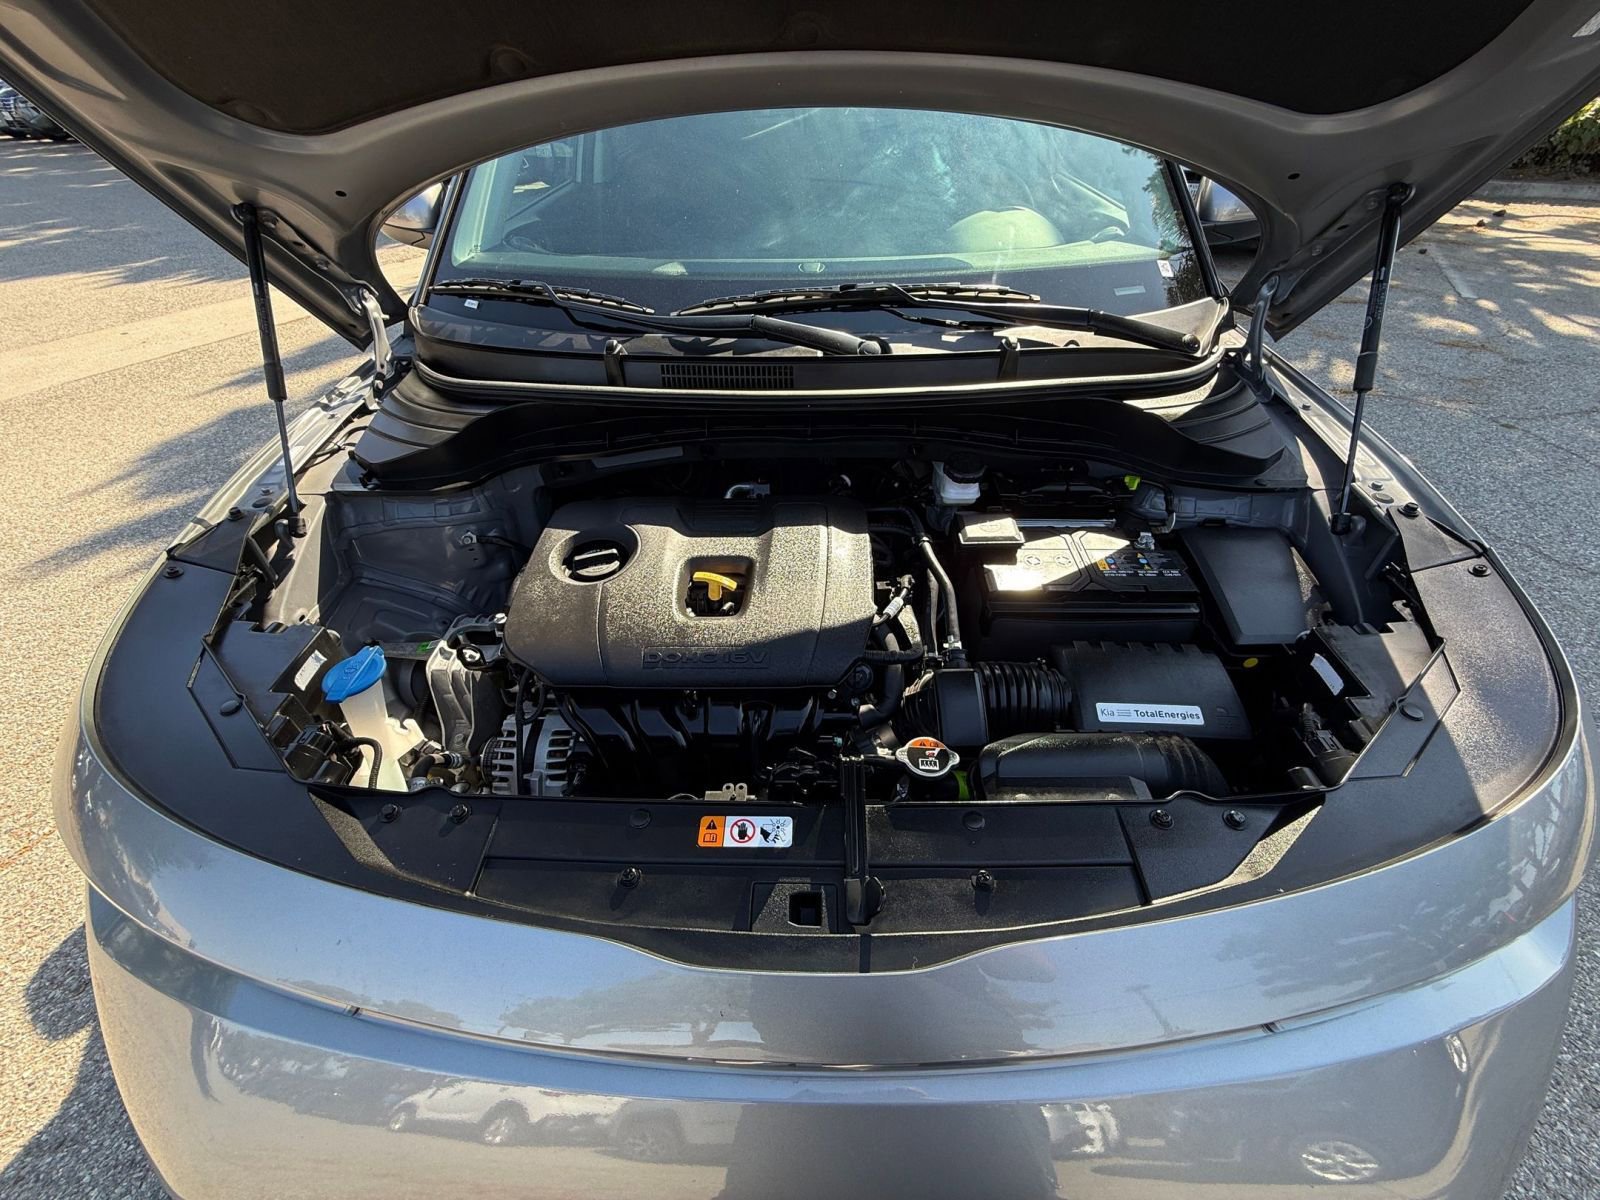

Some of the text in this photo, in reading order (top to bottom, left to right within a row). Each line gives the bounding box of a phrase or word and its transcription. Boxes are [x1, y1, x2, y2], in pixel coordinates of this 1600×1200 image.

[643, 651, 719, 664] DOHC
[1101, 708, 1201, 720] Kia TotalEnergies
